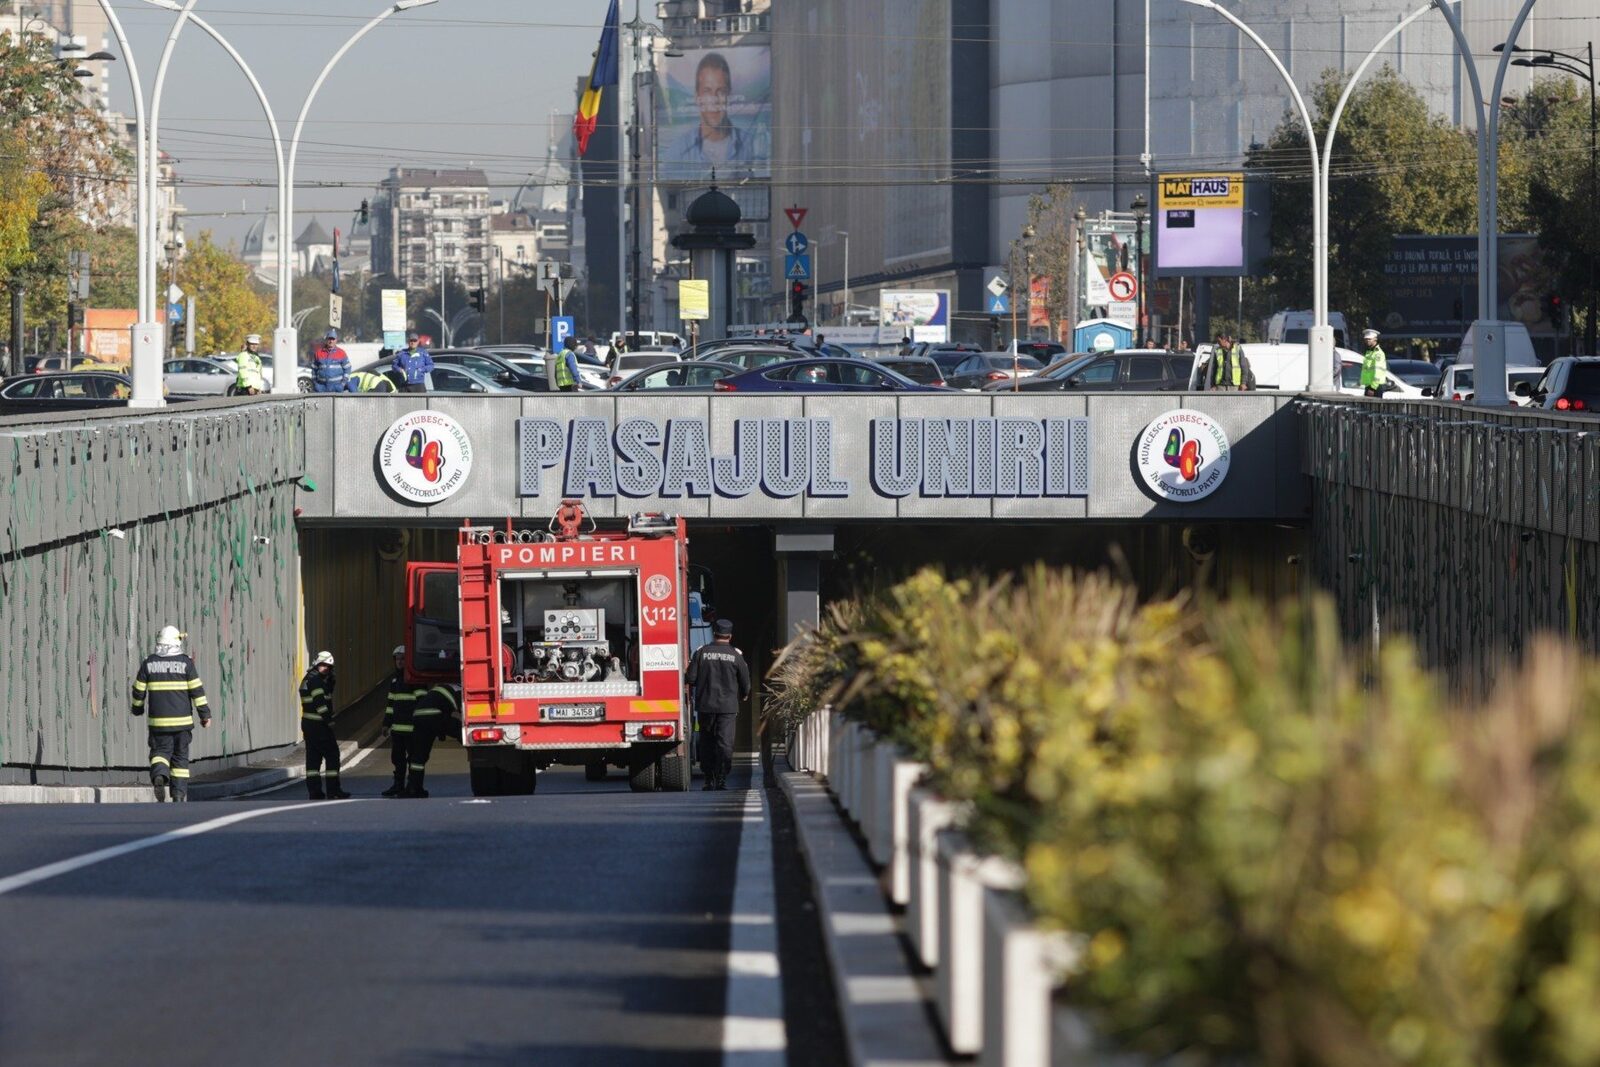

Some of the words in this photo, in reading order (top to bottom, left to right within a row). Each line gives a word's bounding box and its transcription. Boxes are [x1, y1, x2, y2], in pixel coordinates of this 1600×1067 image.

[557, 321, 569, 342] P
[384, 424, 405, 467] MUNCESC
[410, 415, 443, 426] IUBESC
[1141, 423, 1164, 465] MUNCESC
[1168, 414, 1203, 425] IUBESC
[515, 415, 849, 499] PASAJUL
[869, 416, 1091, 499] UNIRII
[393, 472, 402, 484] ÎN
[400, 481, 442, 497] SECTORUL
[441, 468, 463, 493] PATRU
[1150, 471, 1159, 482] ÎN
[1158, 480, 1199, 497] SECTORUL
[1198, 468, 1220, 493] PATRU
[500, 545, 636, 563] POMPIERI
[652, 607, 677, 621] 112
[555, 708, 568, 716] MAI
